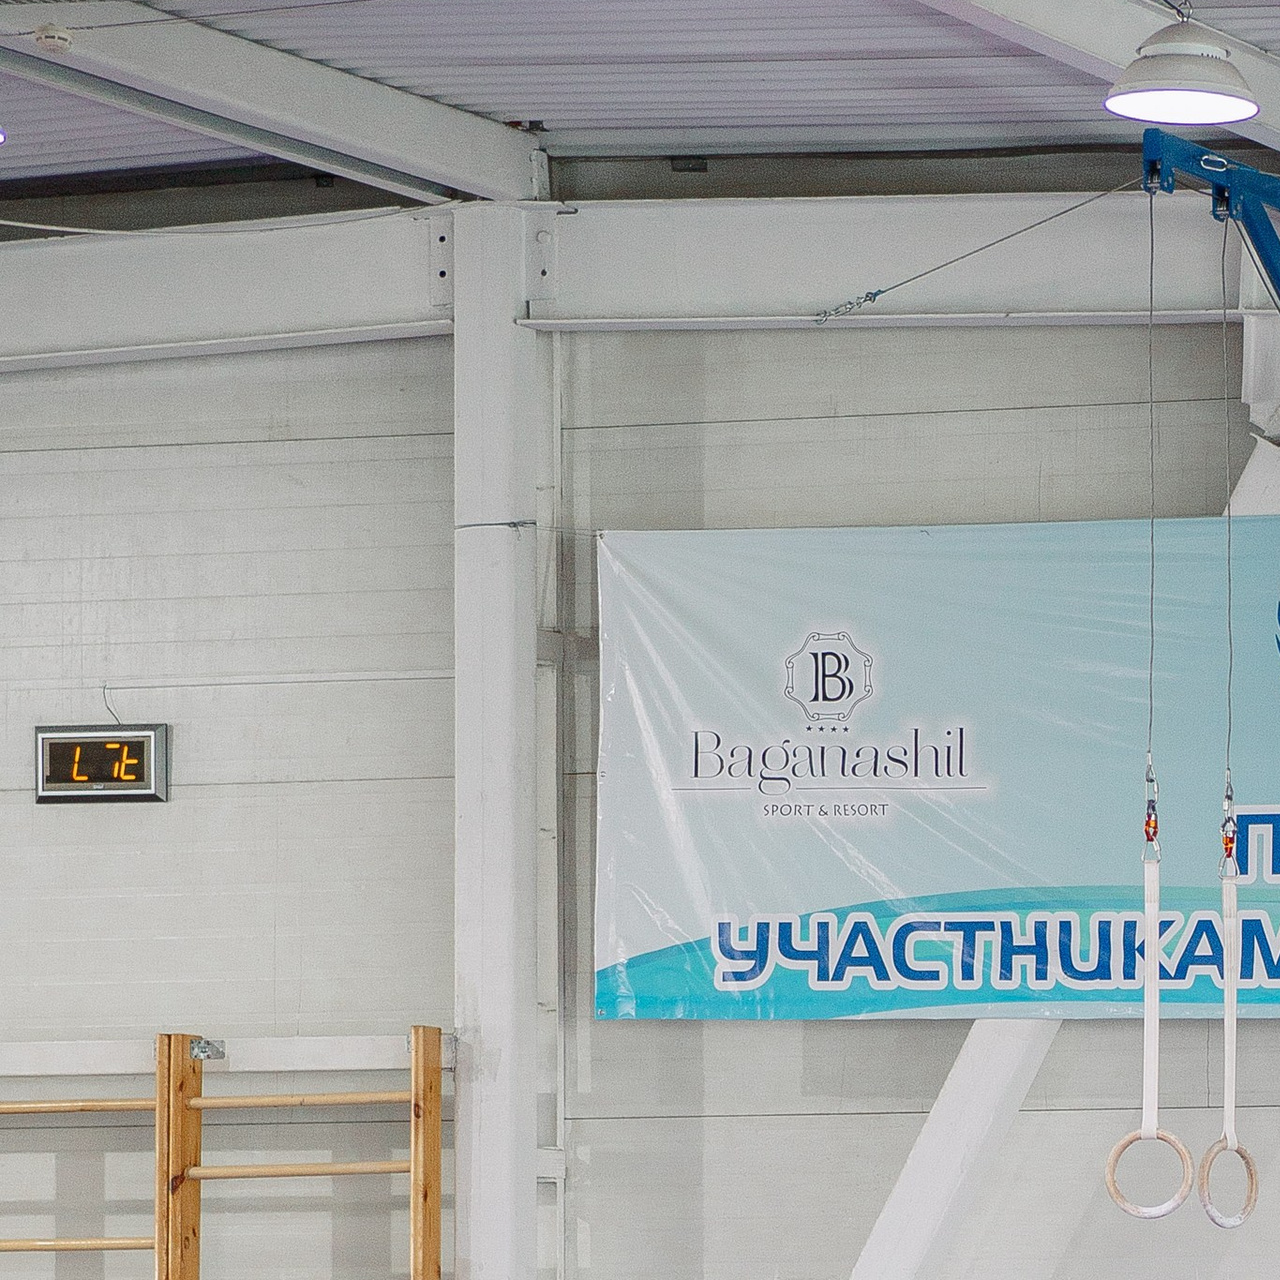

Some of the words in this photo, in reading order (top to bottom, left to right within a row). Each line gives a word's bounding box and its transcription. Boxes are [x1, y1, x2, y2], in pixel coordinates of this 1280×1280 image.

[690, 727, 969, 796] Baganashil
[763, 803, 814, 817] SPORT
[818, 804, 829, 817] &
[833, 803, 889, 817] RESORT
